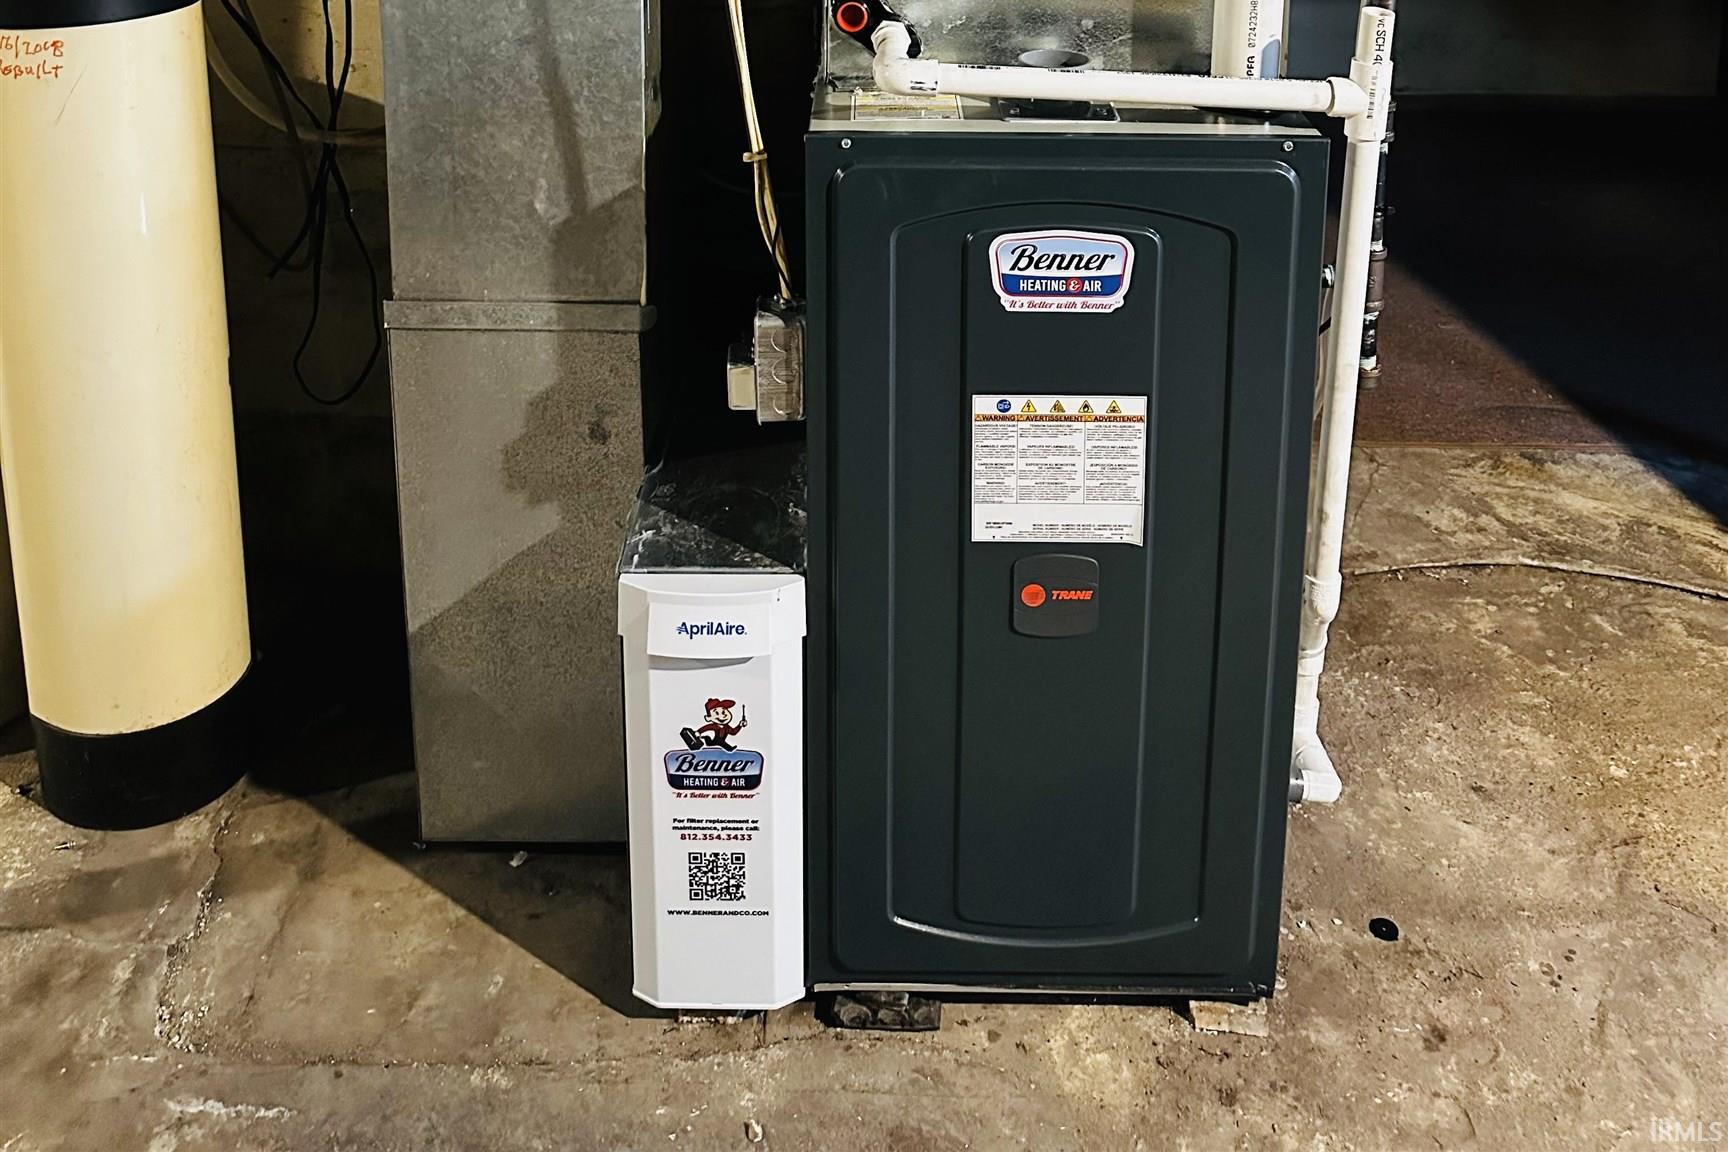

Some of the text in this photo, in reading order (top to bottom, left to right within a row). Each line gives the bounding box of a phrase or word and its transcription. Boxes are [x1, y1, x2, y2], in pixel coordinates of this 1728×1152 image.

[1375, 30, 1387, 52] SCH
[1009, 244, 1116, 273] Benner
[1019, 279, 1102, 292] HEATING & AIR
[1026, 299, 1055, 310] Better
[1056, 299, 1078, 310] with
[982, 414, 1016, 422] WARNING
[1026, 414, 1084, 423] AVERTISSEMENT
[1093, 415, 1144, 423] ADVERTENCIA
[1051, 590, 1094, 600] TRANE
[676, 622, 747, 639] AprilAire
[675, 753, 755, 773] Benner
[683, 777, 746, 787] HEATING & AIR
[680, 833, 753, 841] 812.354.3433
